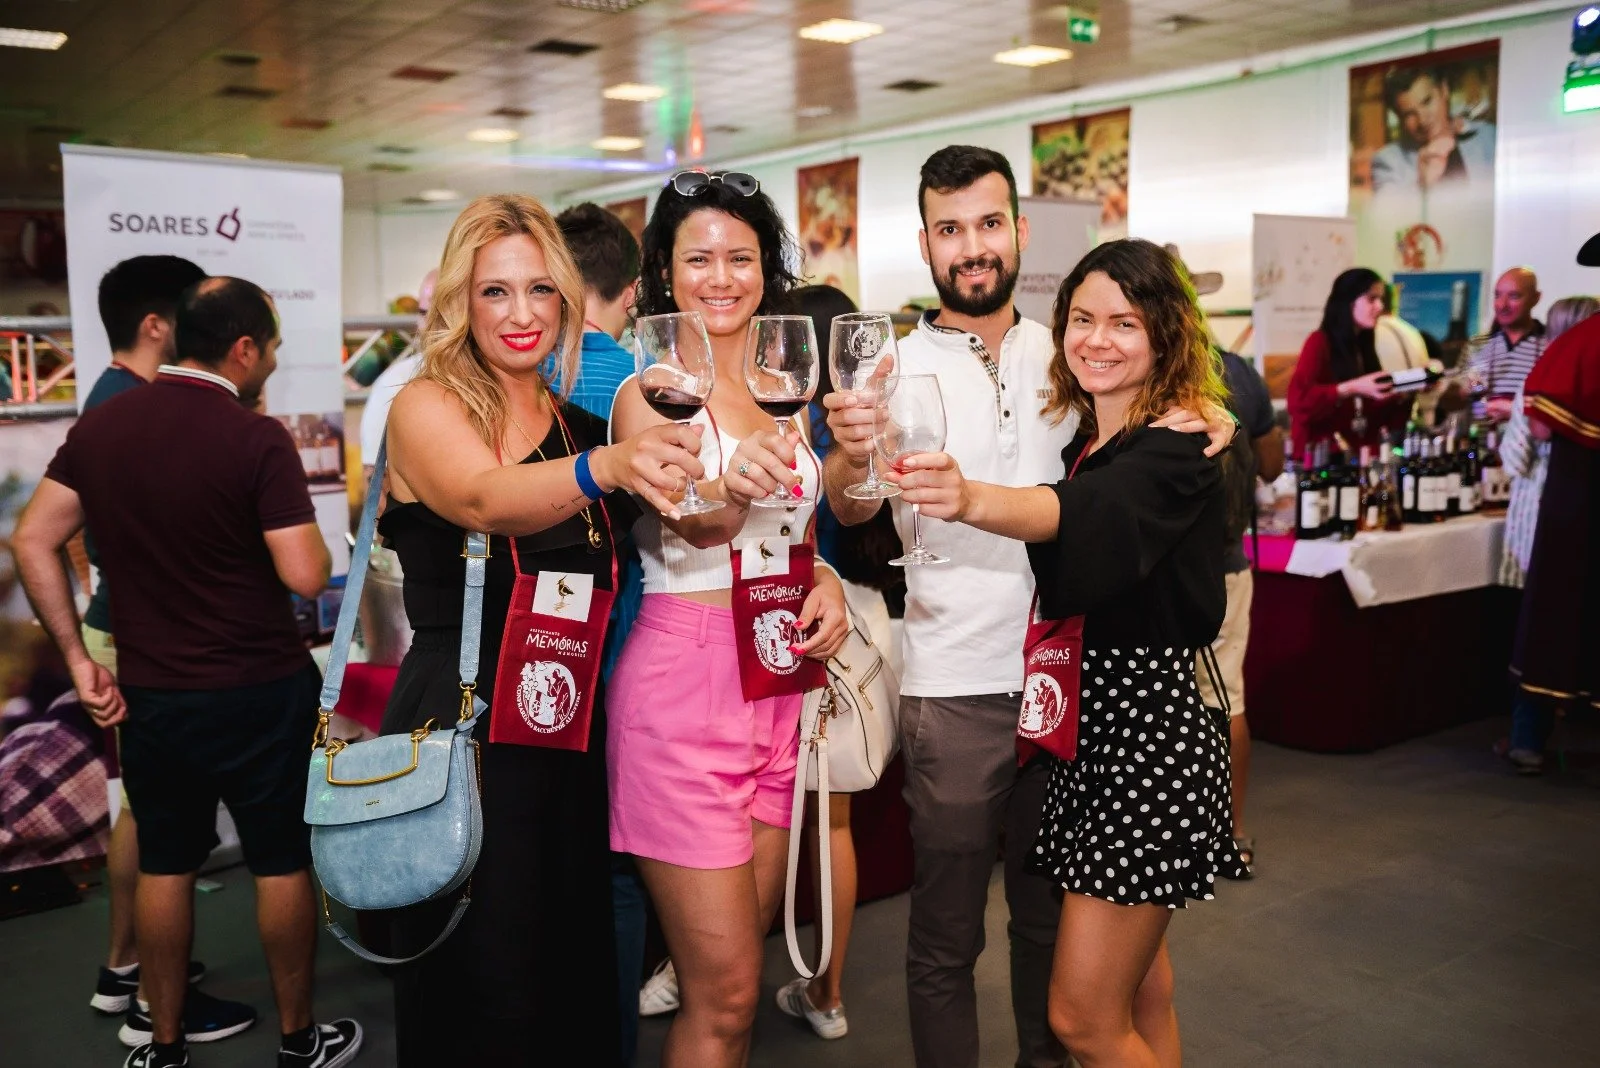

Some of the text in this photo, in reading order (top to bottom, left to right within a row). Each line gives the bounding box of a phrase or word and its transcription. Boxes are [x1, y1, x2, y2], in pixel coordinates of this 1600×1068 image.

[109, 212, 209, 236] SOARES
[749, 585, 803, 602] MEMÓRIAS
[526, 633, 588, 653] MEMÓRIAS
